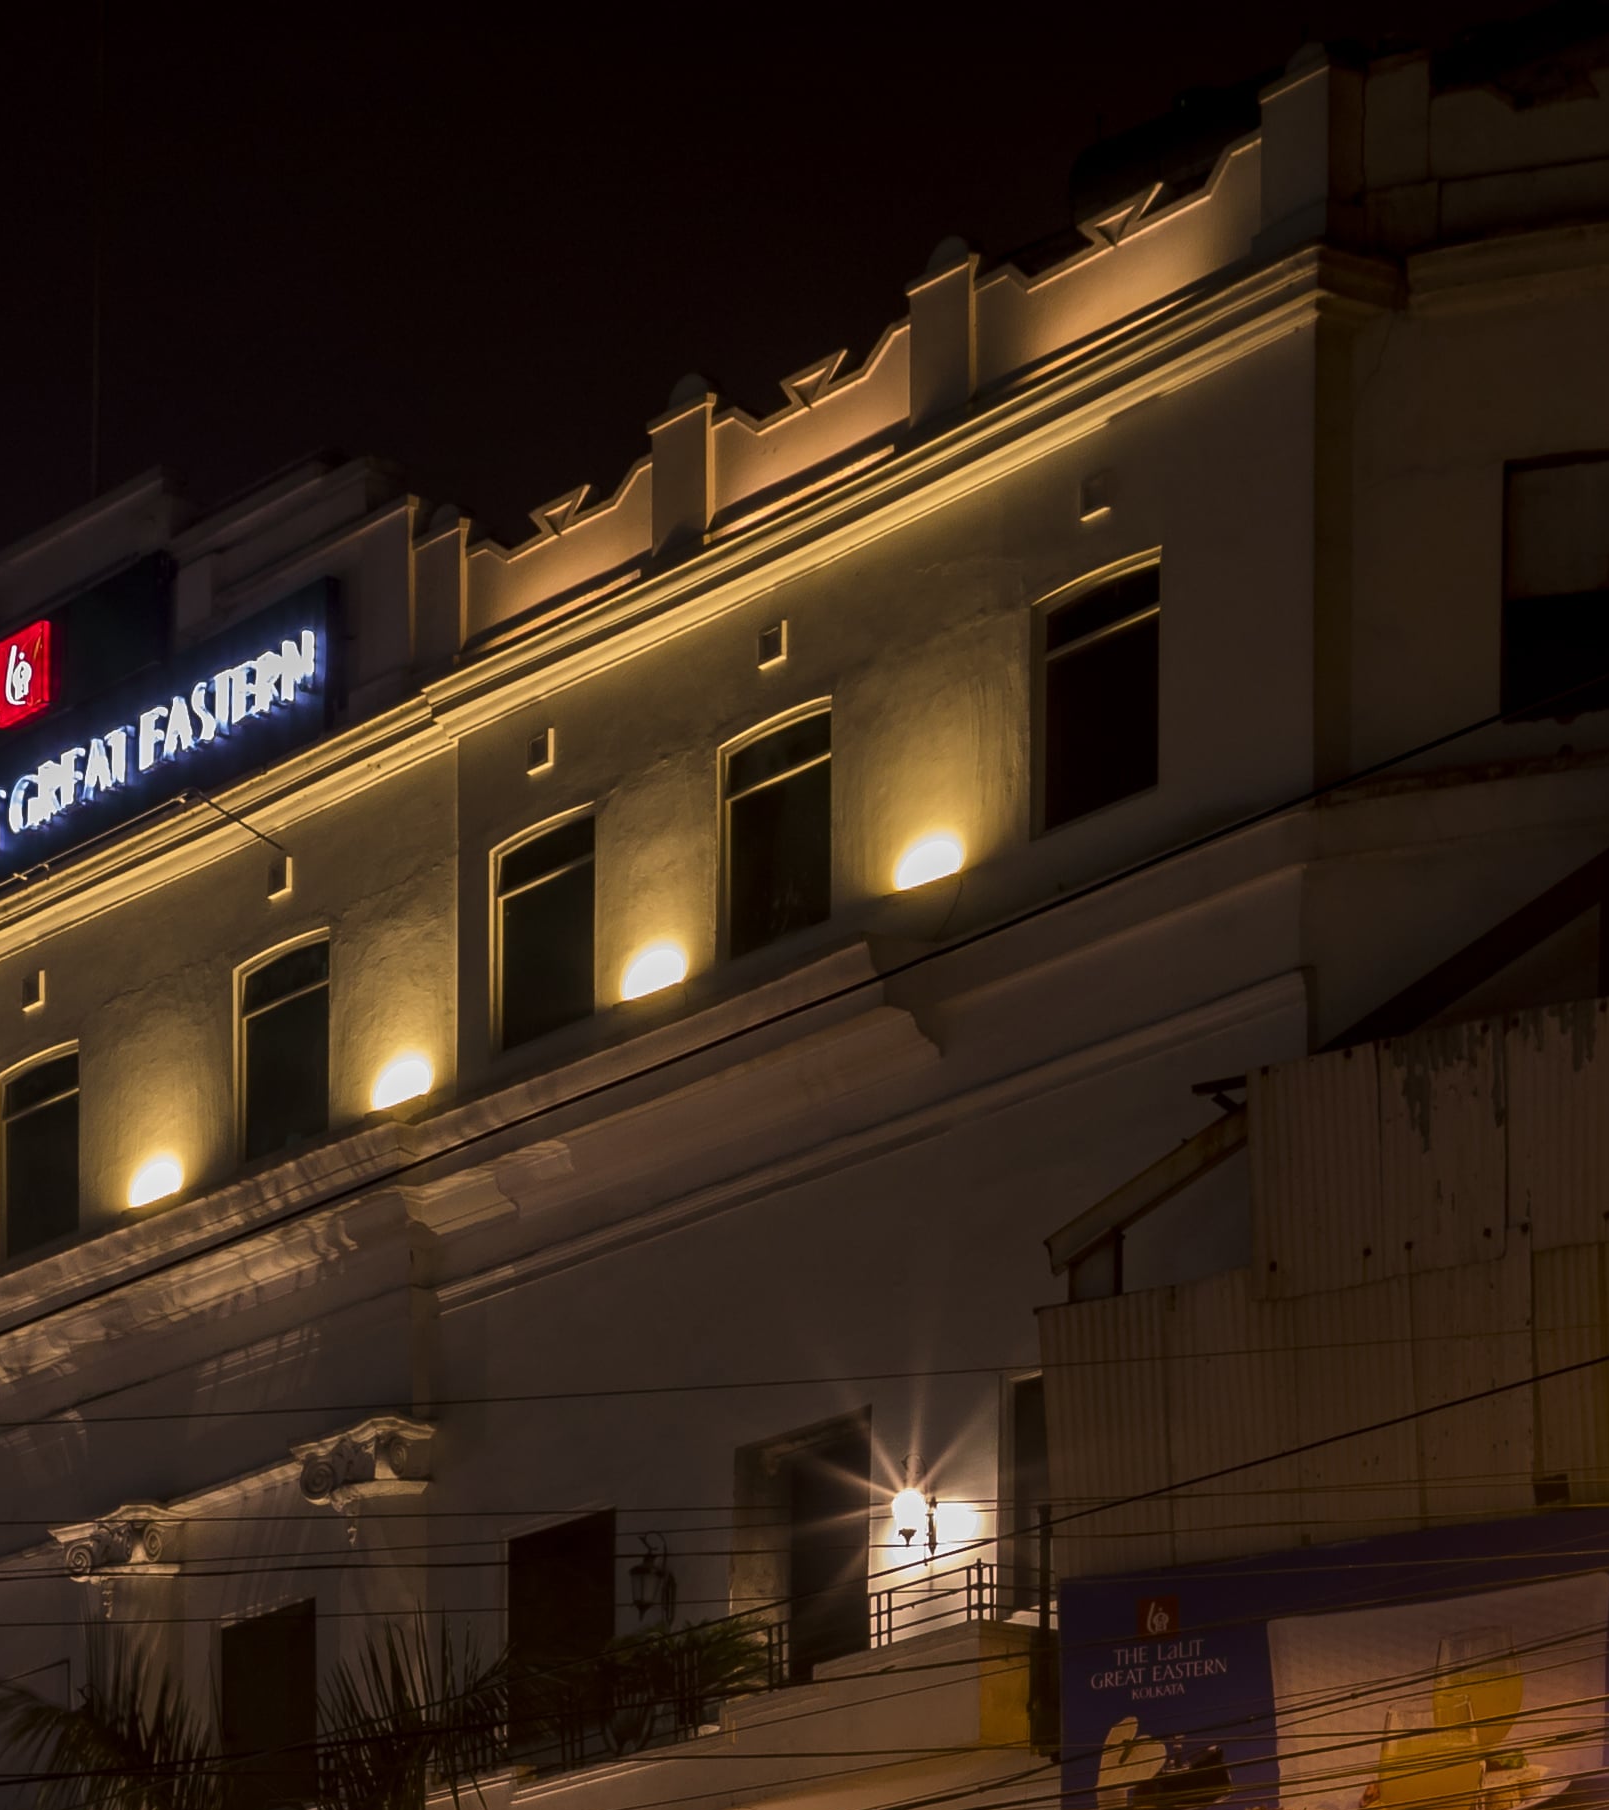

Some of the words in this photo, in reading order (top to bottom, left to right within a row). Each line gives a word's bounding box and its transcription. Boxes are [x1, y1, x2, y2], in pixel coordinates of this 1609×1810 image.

[1113, 1645, 1149, 1667] THE
[1090, 1667, 1147, 1690] GREAT
[1152, 1657, 1228, 1682] EASTERN
[1132, 1683, 1185, 1700] KOLKATA
